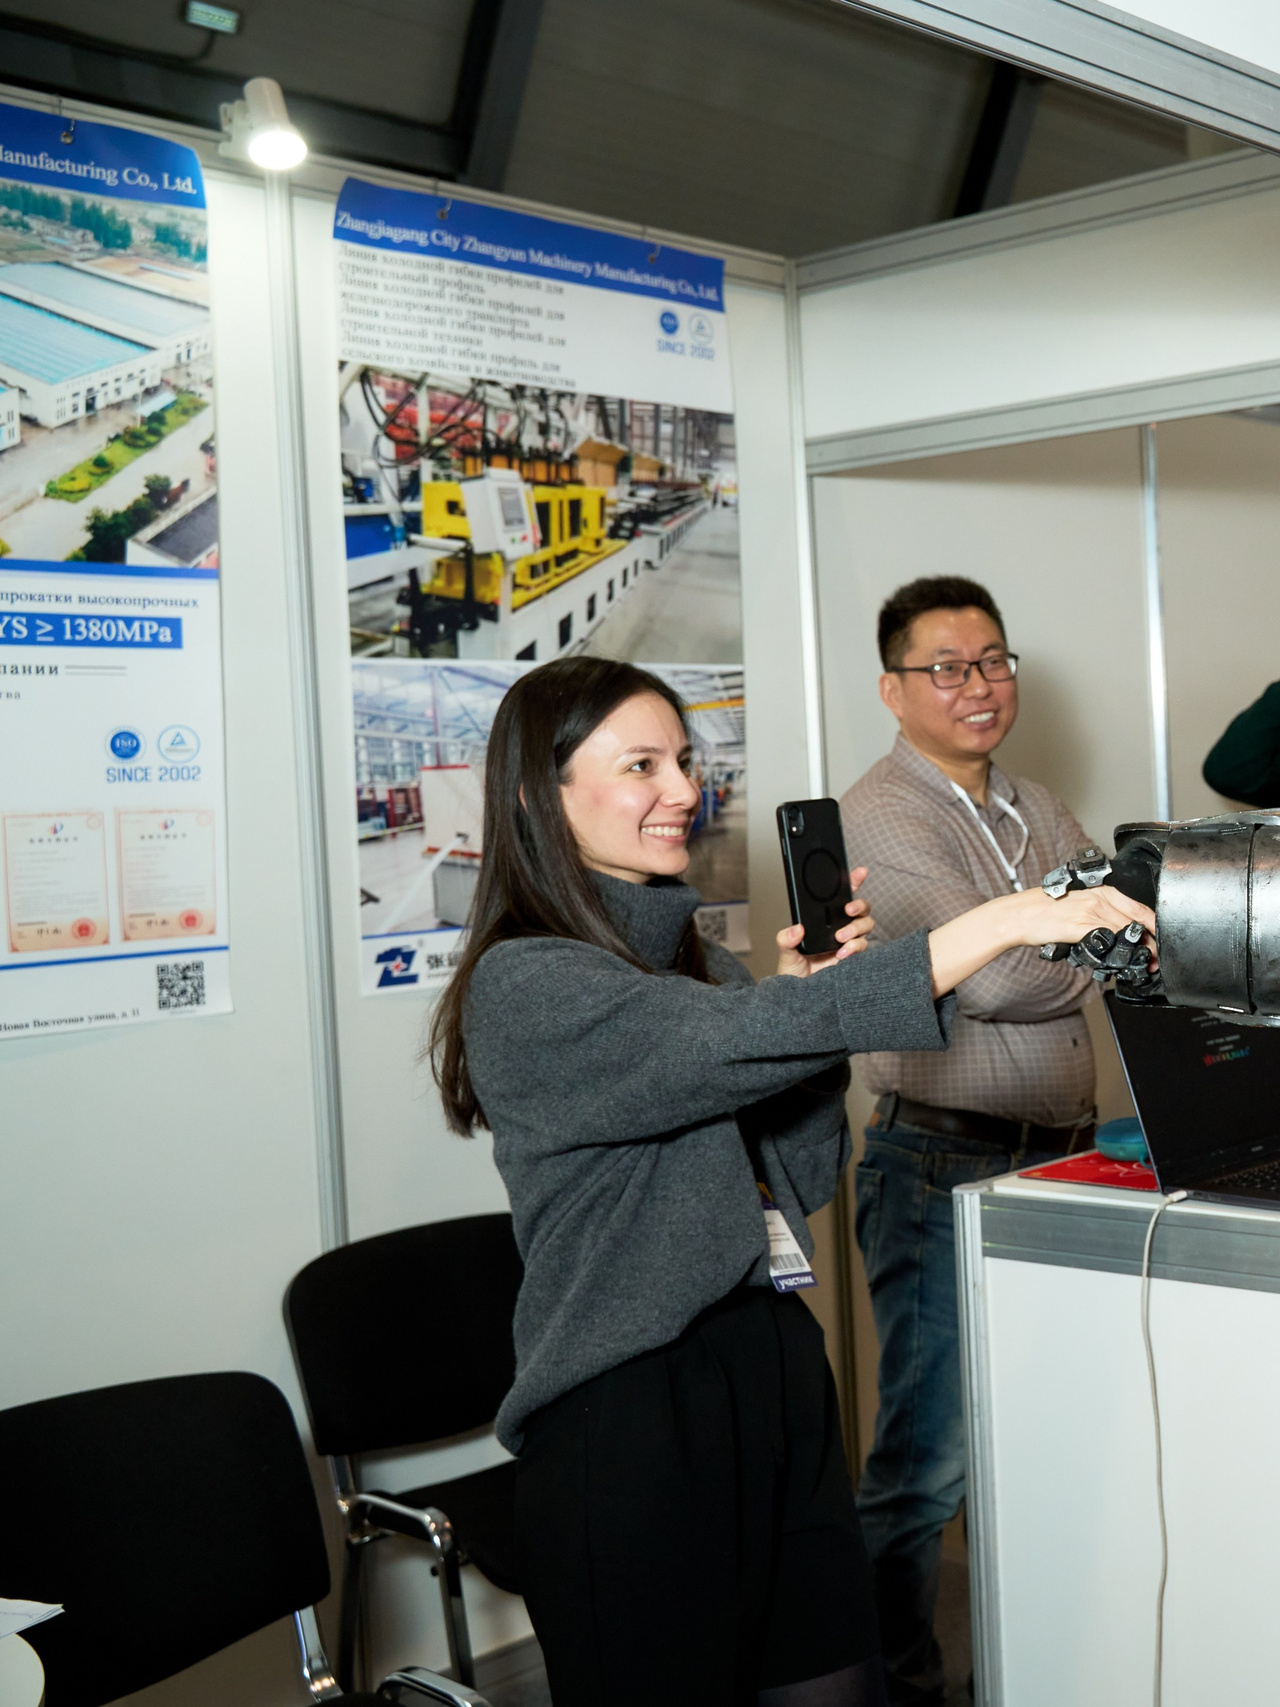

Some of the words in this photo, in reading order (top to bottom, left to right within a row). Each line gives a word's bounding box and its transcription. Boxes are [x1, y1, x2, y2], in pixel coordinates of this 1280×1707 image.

[122, 167, 158, 191] Co.,
[163, 172, 197, 195] Ltd.
[336, 210, 429, 247] Zhangjiagang
[430, 229, 461, 252] City
[462, 234, 527, 262] Zhangyun
[529, 248, 592, 278] Machinery
[594, 261, 677, 295] Manufacturing
[0, 591, 72, 604] прокатки
[78, 594, 199, 609] высокопрочных
[62, 618, 173, 643] 1380MPa
[106, 766, 152, 783] SINCE
[159, 765, 201, 782] 2002
[778, 1276, 815, 1290] участник
